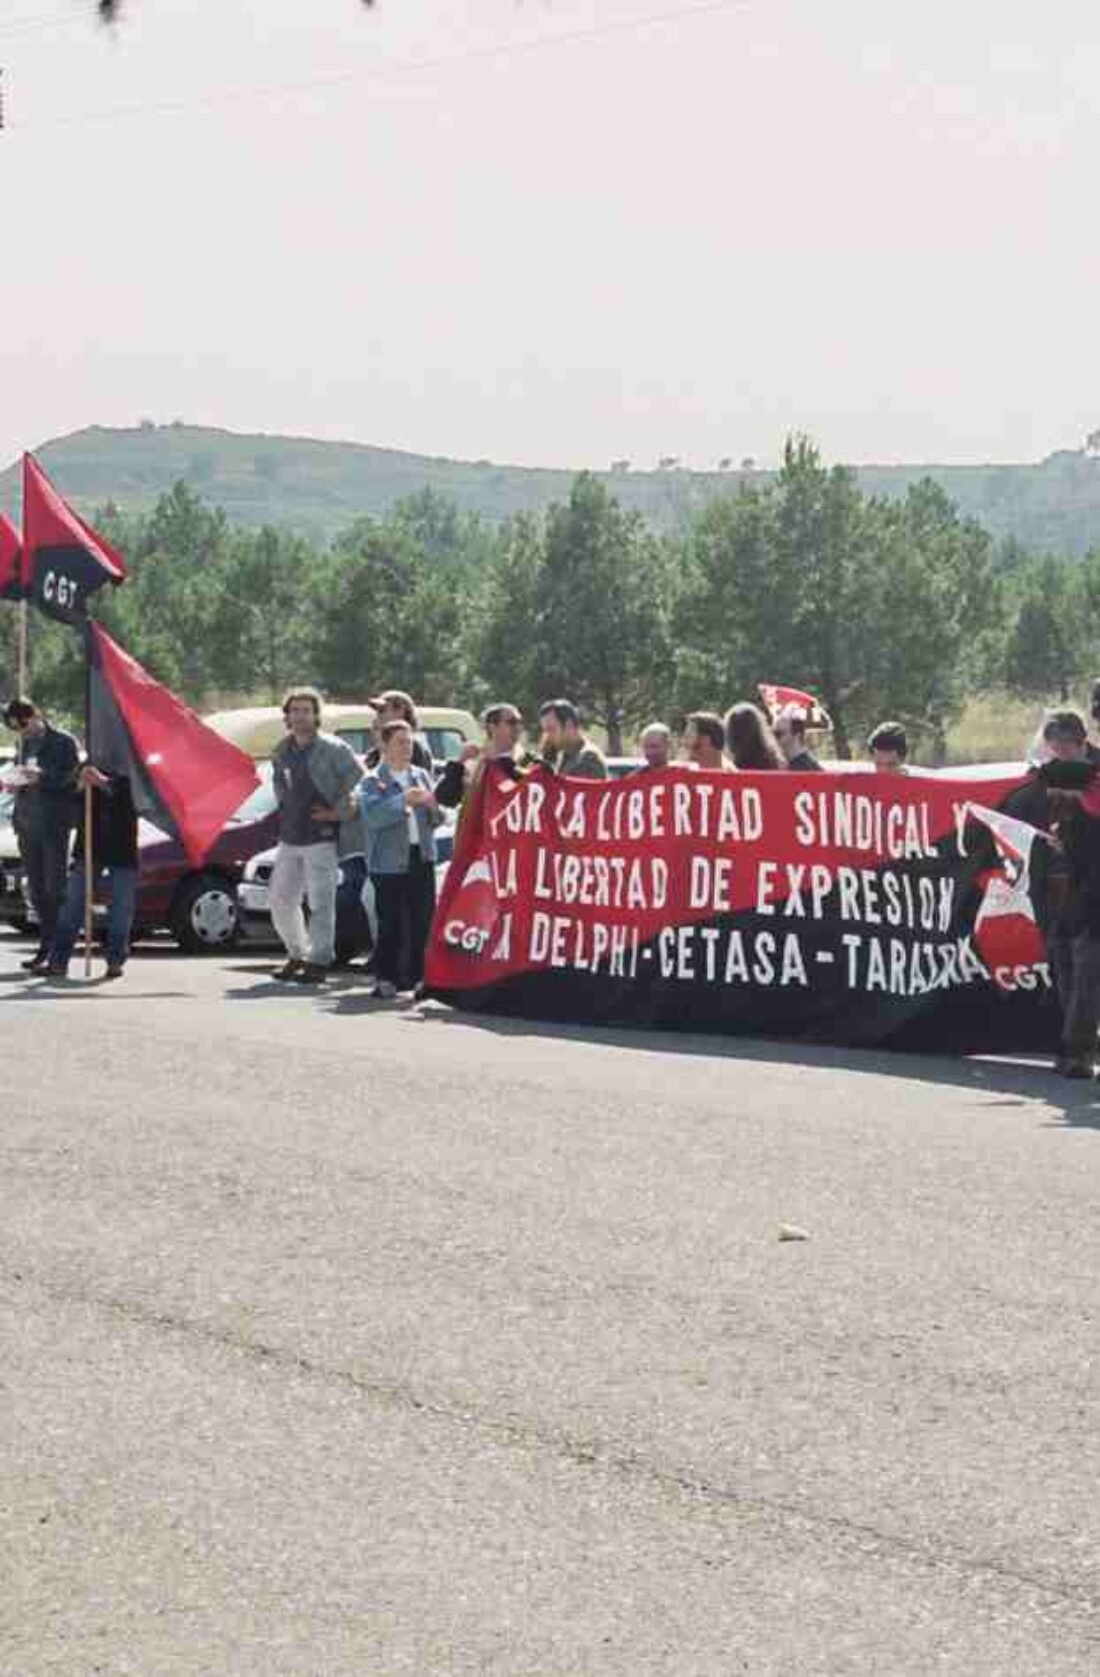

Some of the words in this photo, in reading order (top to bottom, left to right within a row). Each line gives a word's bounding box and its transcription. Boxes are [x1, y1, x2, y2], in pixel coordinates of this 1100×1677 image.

[43, 571, 77, 607] CGT
[597, 783, 763, 841] LIBERTAD
[794, 792, 938, 859] SINDICAL
[534, 848, 668, 909] LIBERTAD
[690, 856, 732, 910] DE
[755, 861, 954, 934] EXPRESION
[444, 920, 490, 954] CGT
[994, 962, 1053, 991] CGT
